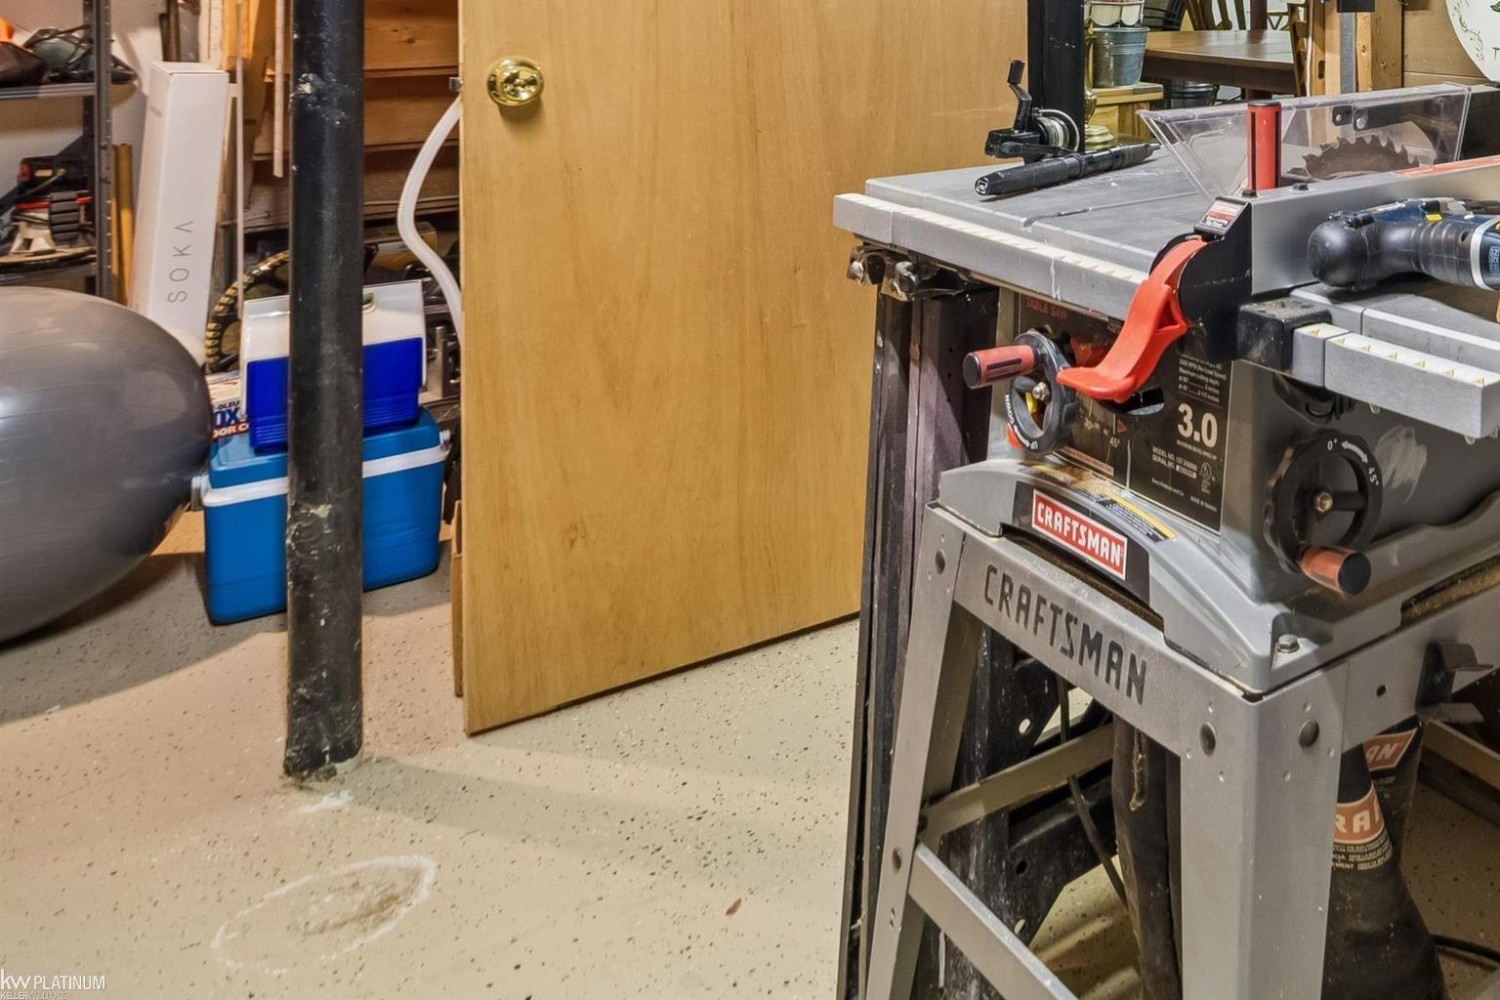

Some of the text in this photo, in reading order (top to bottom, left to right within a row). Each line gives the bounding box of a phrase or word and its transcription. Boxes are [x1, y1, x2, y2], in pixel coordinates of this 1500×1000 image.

[1176, 402, 1219, 449] 3.0
[1368, 467, 1380, 487] 45°
[1036, 501, 1121, 568] CRAFTSMAN
[984, 563, 1147, 705] CRAFTSMAN
